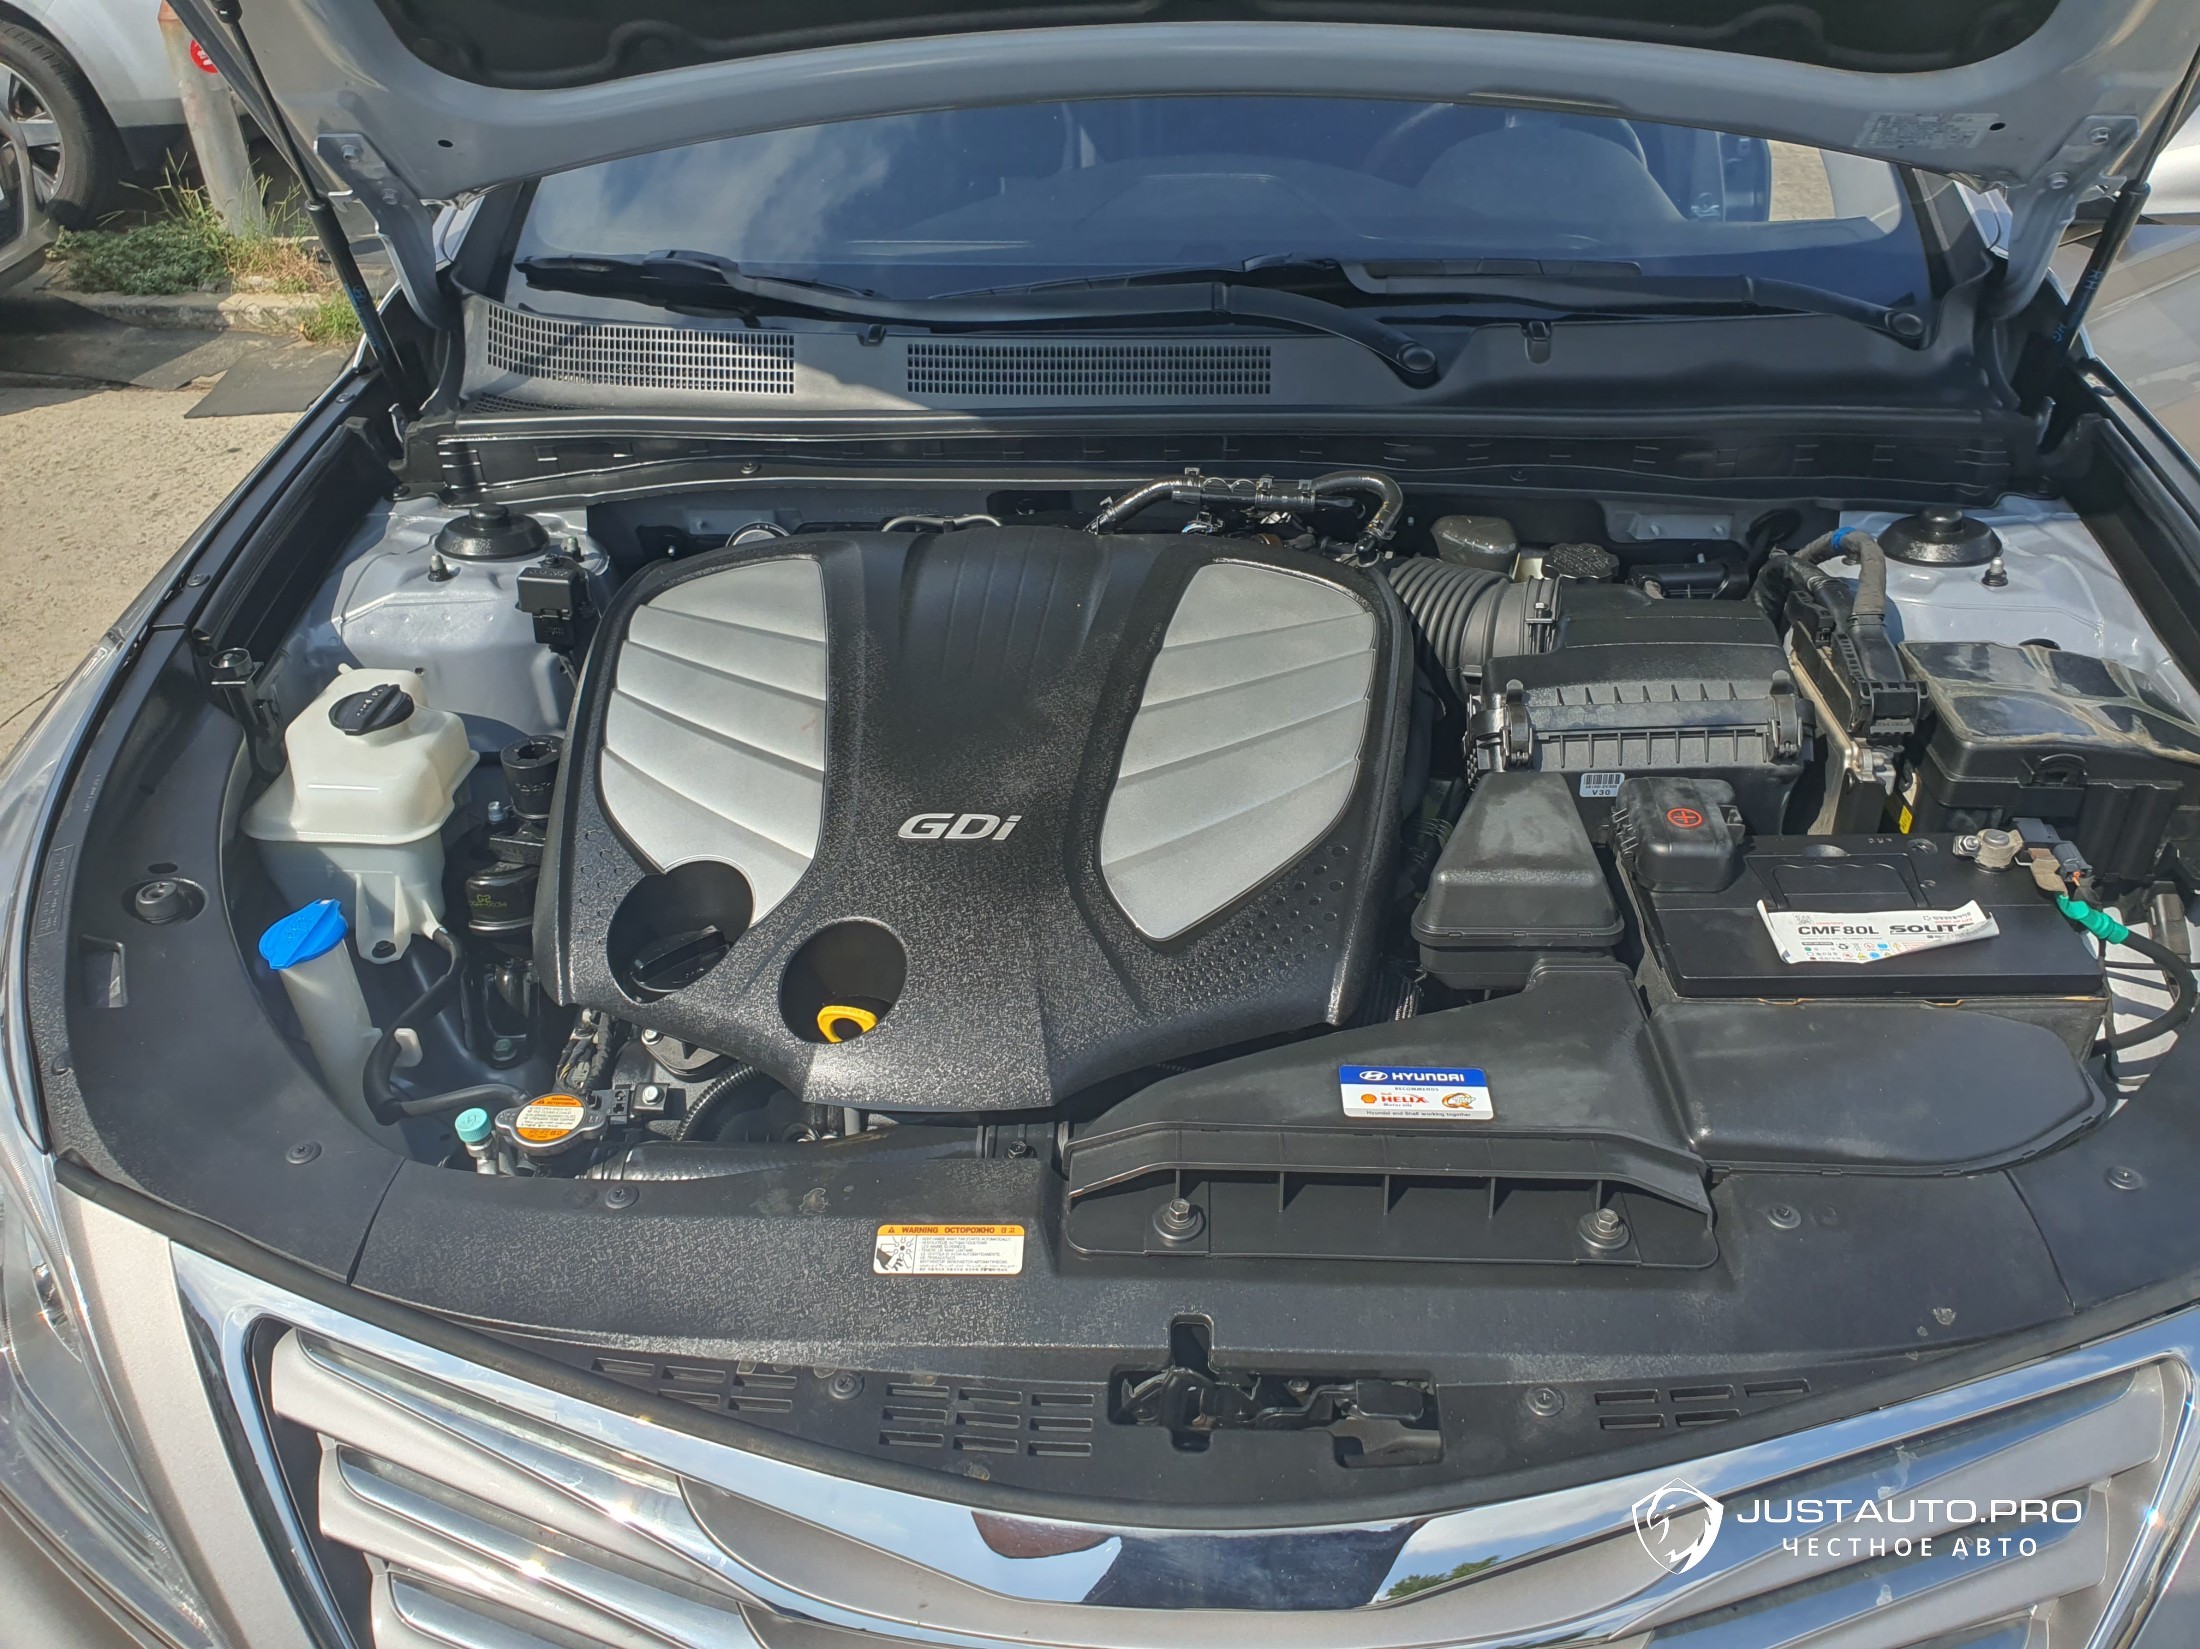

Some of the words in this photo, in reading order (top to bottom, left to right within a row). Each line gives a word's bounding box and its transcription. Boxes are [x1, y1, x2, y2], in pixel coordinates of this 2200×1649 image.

[898, 813, 1022, 840] GDi
[1889, 922, 1974, 934] SOLIT
[1392, 1072, 1465, 1082] HYUNDAI
